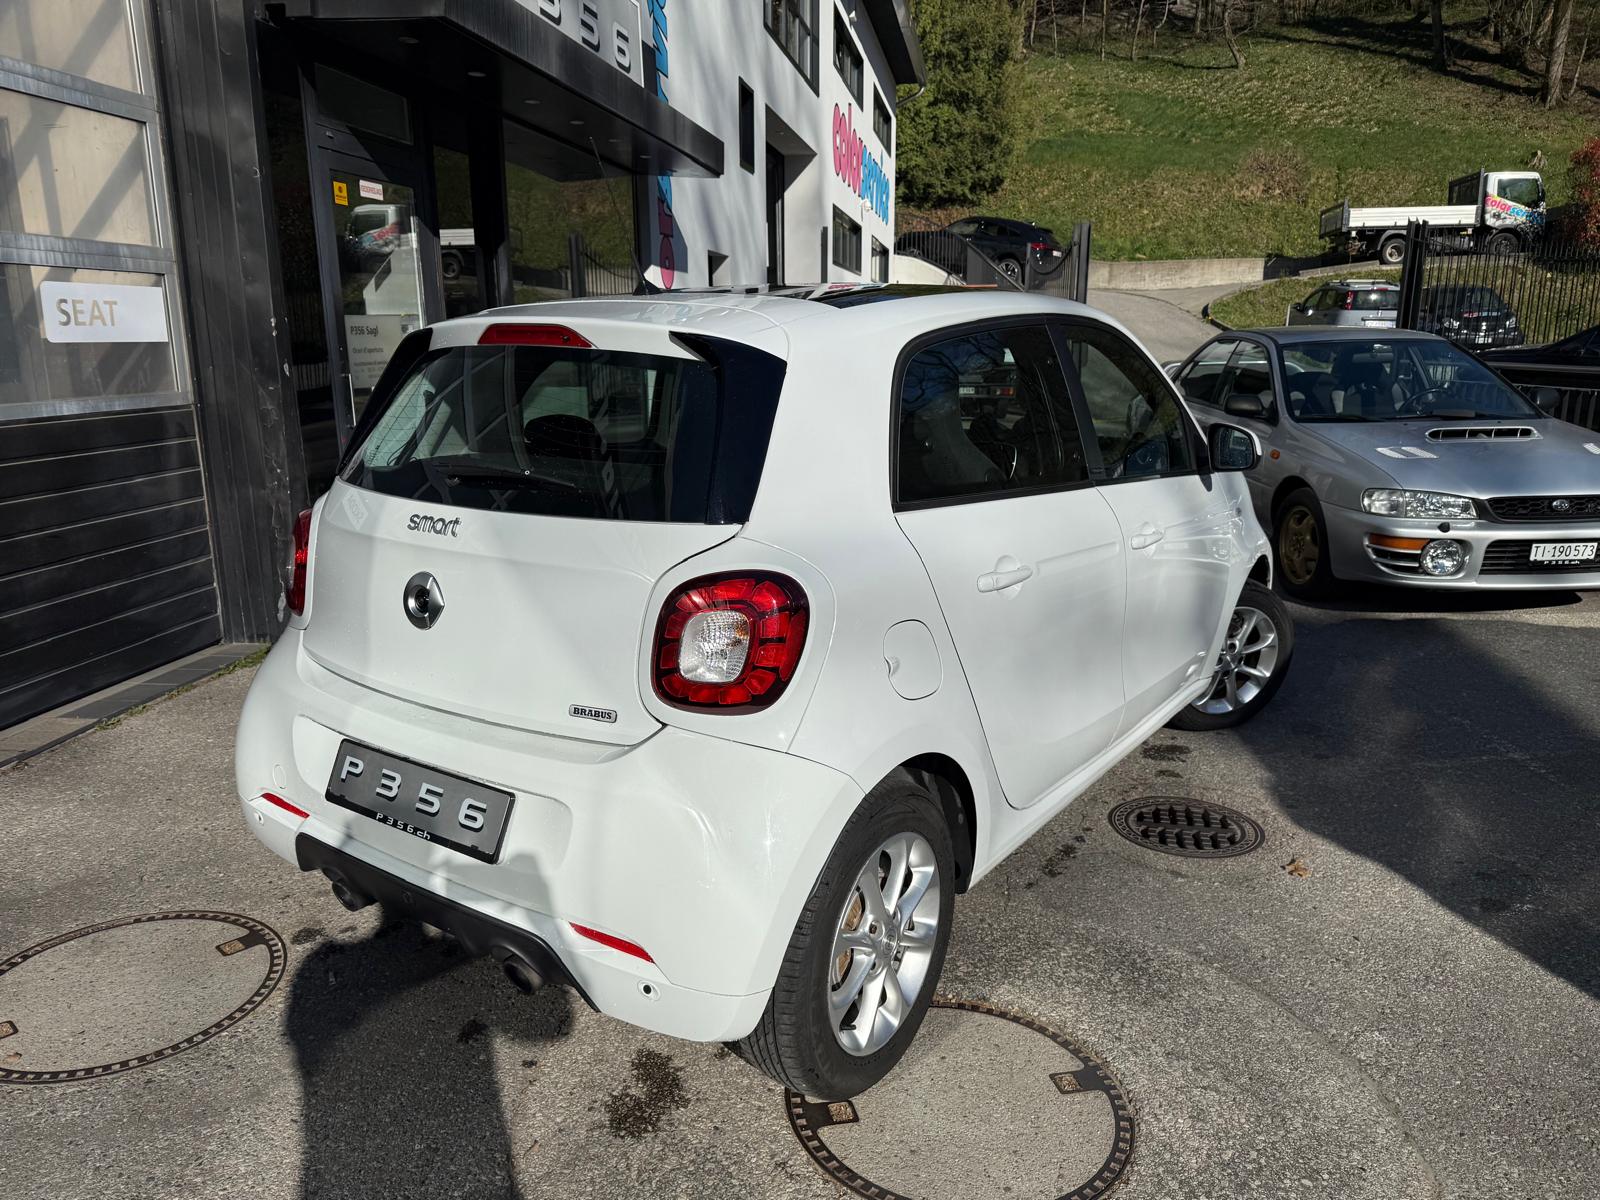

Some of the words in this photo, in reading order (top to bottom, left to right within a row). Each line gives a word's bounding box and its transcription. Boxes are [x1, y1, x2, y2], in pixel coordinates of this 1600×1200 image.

[55, 298, 118, 328] SEAT
[407, 513, 461, 538] smart
[573, 707, 612, 720] BRABUS
